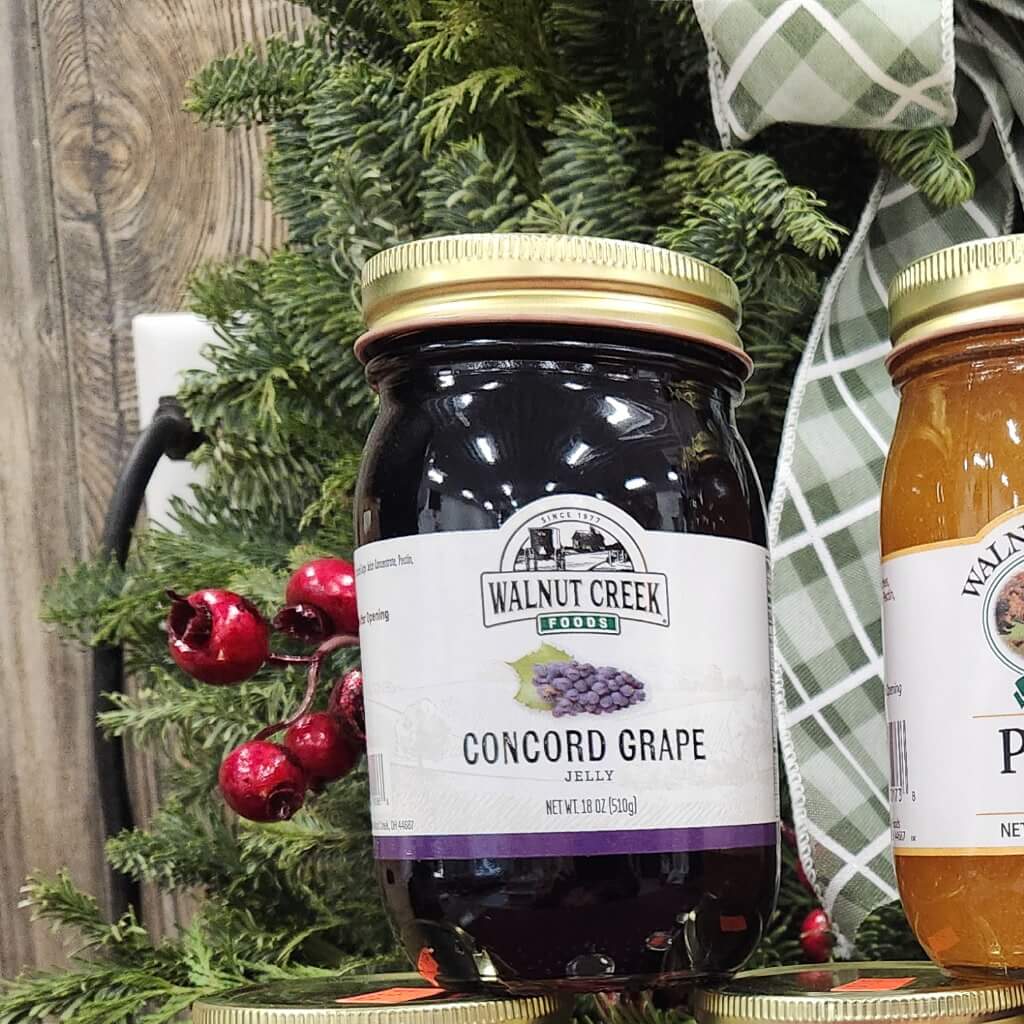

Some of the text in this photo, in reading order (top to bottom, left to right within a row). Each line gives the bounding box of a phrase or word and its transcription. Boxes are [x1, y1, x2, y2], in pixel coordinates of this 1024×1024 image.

[541, 511, 572, 523] SINCE
[489, 579, 663, 616] WALNUT CREEK
[549, 617, 608, 629] FOODS
[463, 728, 706, 765] CONCORD GRAPE
[564, 769, 615, 783] JELLY
[547, 799, 564, 815] NET
[582, 798, 593, 813] 18
[595, 797, 608, 813] OZ
[609, 796, 638, 816] (510g)
